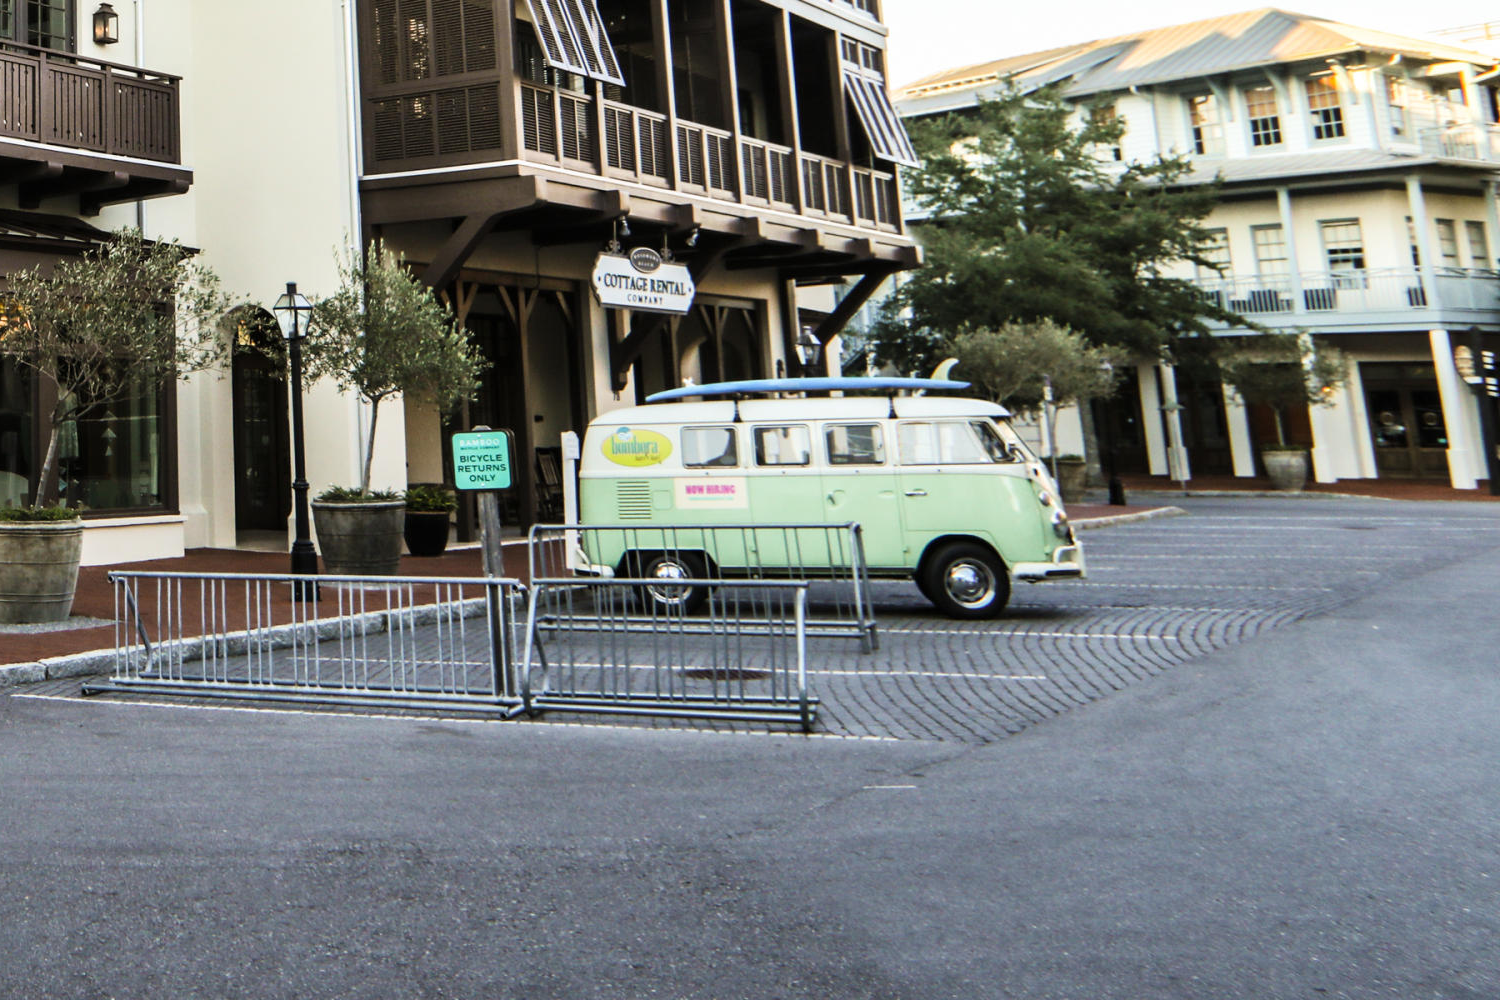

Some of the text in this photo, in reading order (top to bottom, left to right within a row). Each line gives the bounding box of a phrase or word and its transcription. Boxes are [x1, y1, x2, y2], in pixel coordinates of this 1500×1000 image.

[604, 272, 686, 296] COTTAGE RENTAL
[627, 293, 663, 305] COMPANY
[459, 438, 500, 447] BAMBOO
[611, 435, 659, 456] bombora
[460, 454, 503, 463] BICYCLE
[457, 463, 507, 473] RETURNS
[469, 474, 496, 482] ONLY
[685, 484, 736, 494] NOW HIRING
